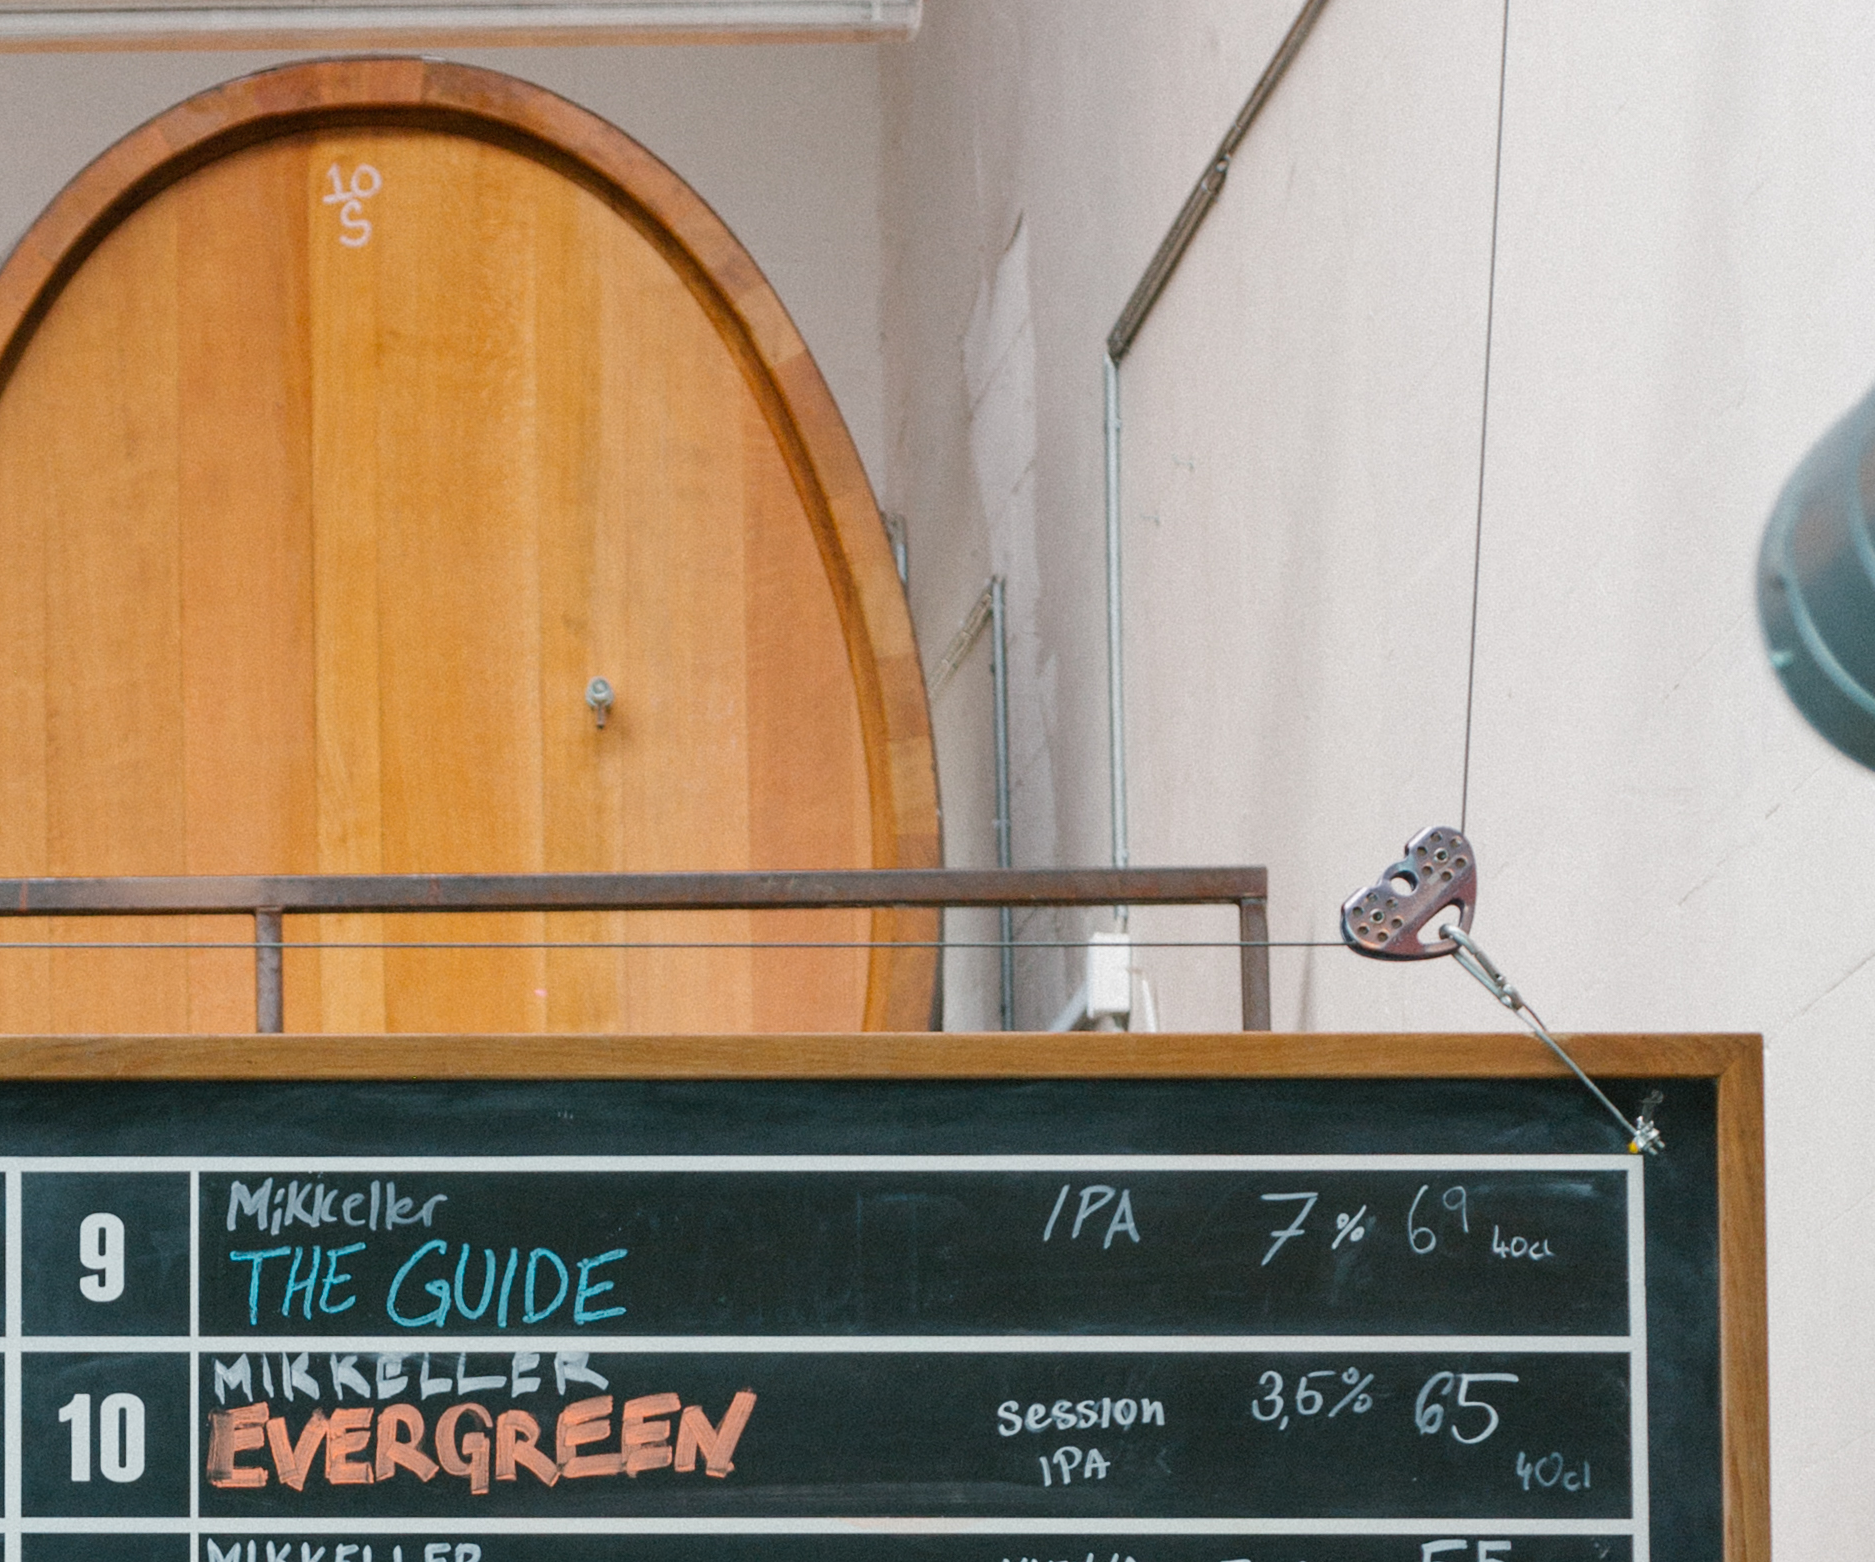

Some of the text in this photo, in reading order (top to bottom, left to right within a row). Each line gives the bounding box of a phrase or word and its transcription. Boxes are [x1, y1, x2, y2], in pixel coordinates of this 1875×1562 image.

[323, 162, 382, 204] 10
[1042, 1185, 1141, 1249] IPA
[79, 1213, 125, 1302] 9
[230, 1238, 628, 1329] THE GUIDE
[213, 1352, 609, 1402] MIKKELLER
[1414, 1372, 1520, 1445] 65
[57, 1392, 145, 1483] 10
[206, 1387, 758, 1495] EVERGREEN
[1038, 1446, 1110, 1487] IPA
